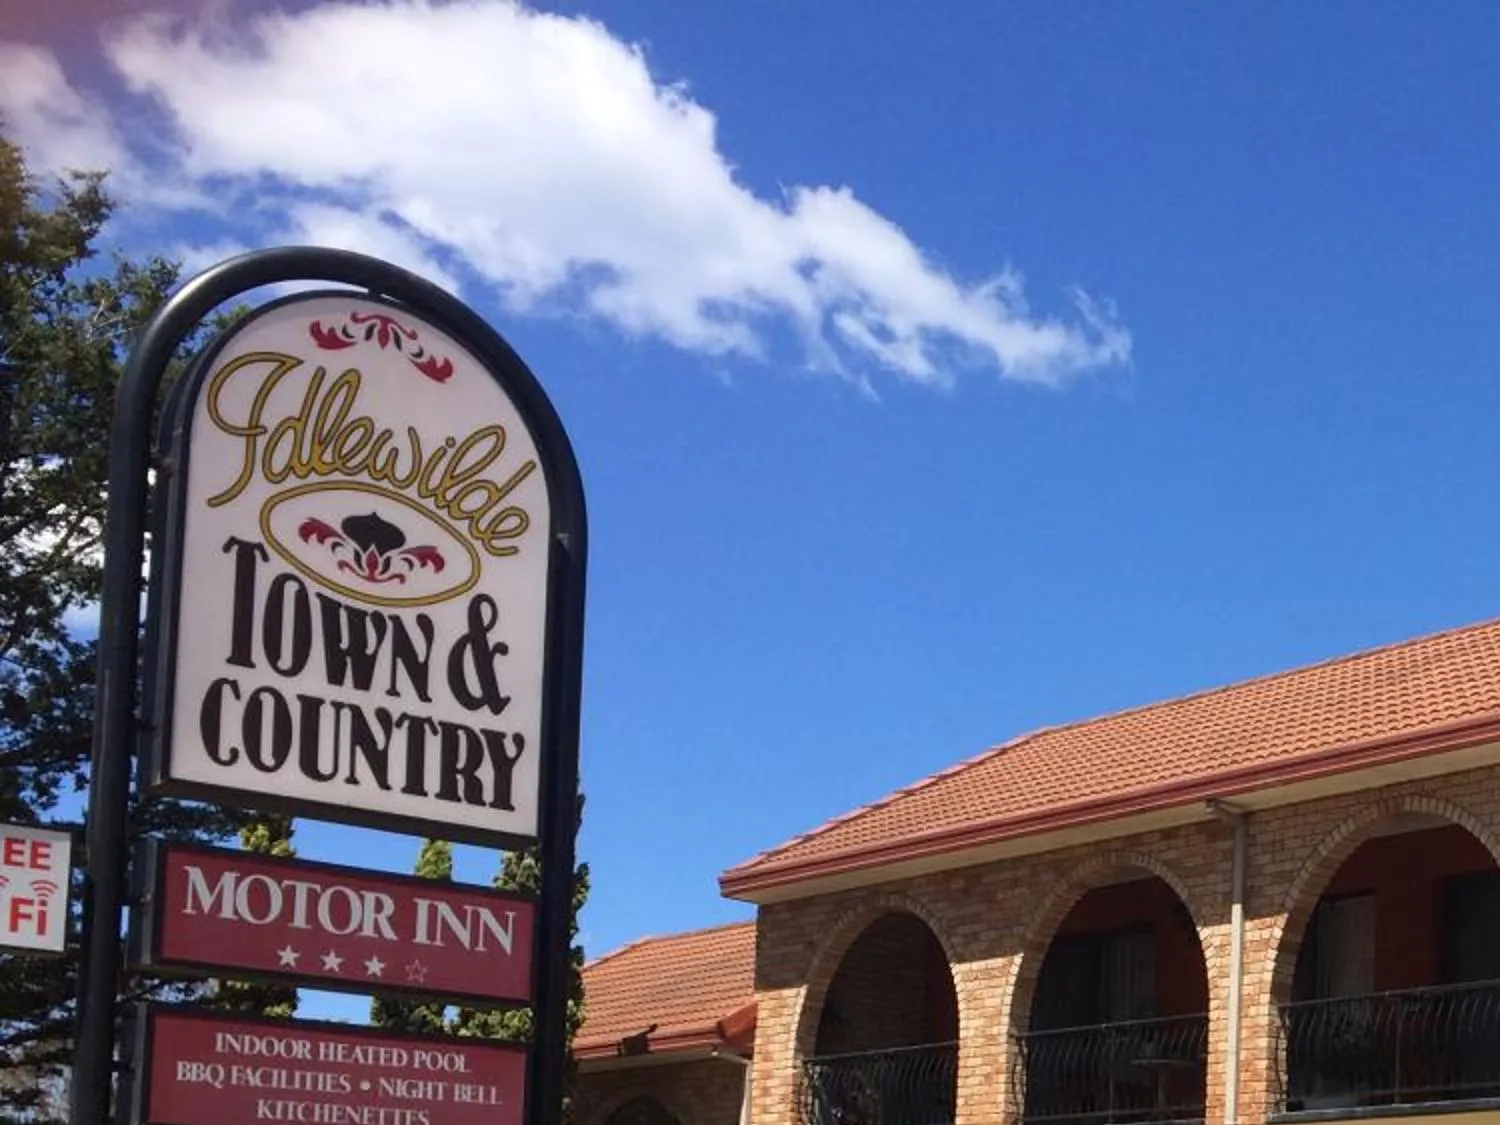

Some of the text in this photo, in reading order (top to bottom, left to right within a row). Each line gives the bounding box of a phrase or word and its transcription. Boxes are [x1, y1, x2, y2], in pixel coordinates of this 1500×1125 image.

[206, 352, 536, 556] Idlewilde
[222, 536, 511, 715] TOWN &
[200, 678, 525, 812] COUNTRY
[8, 897, 48, 936] Fi
[182, 865, 517, 955] MOTOR INN
[176, 1061, 503, 1106] BBQ FACILITIES NIGHT BELL
[214, 1031, 471, 1074] INDOOR HEATED POOL
